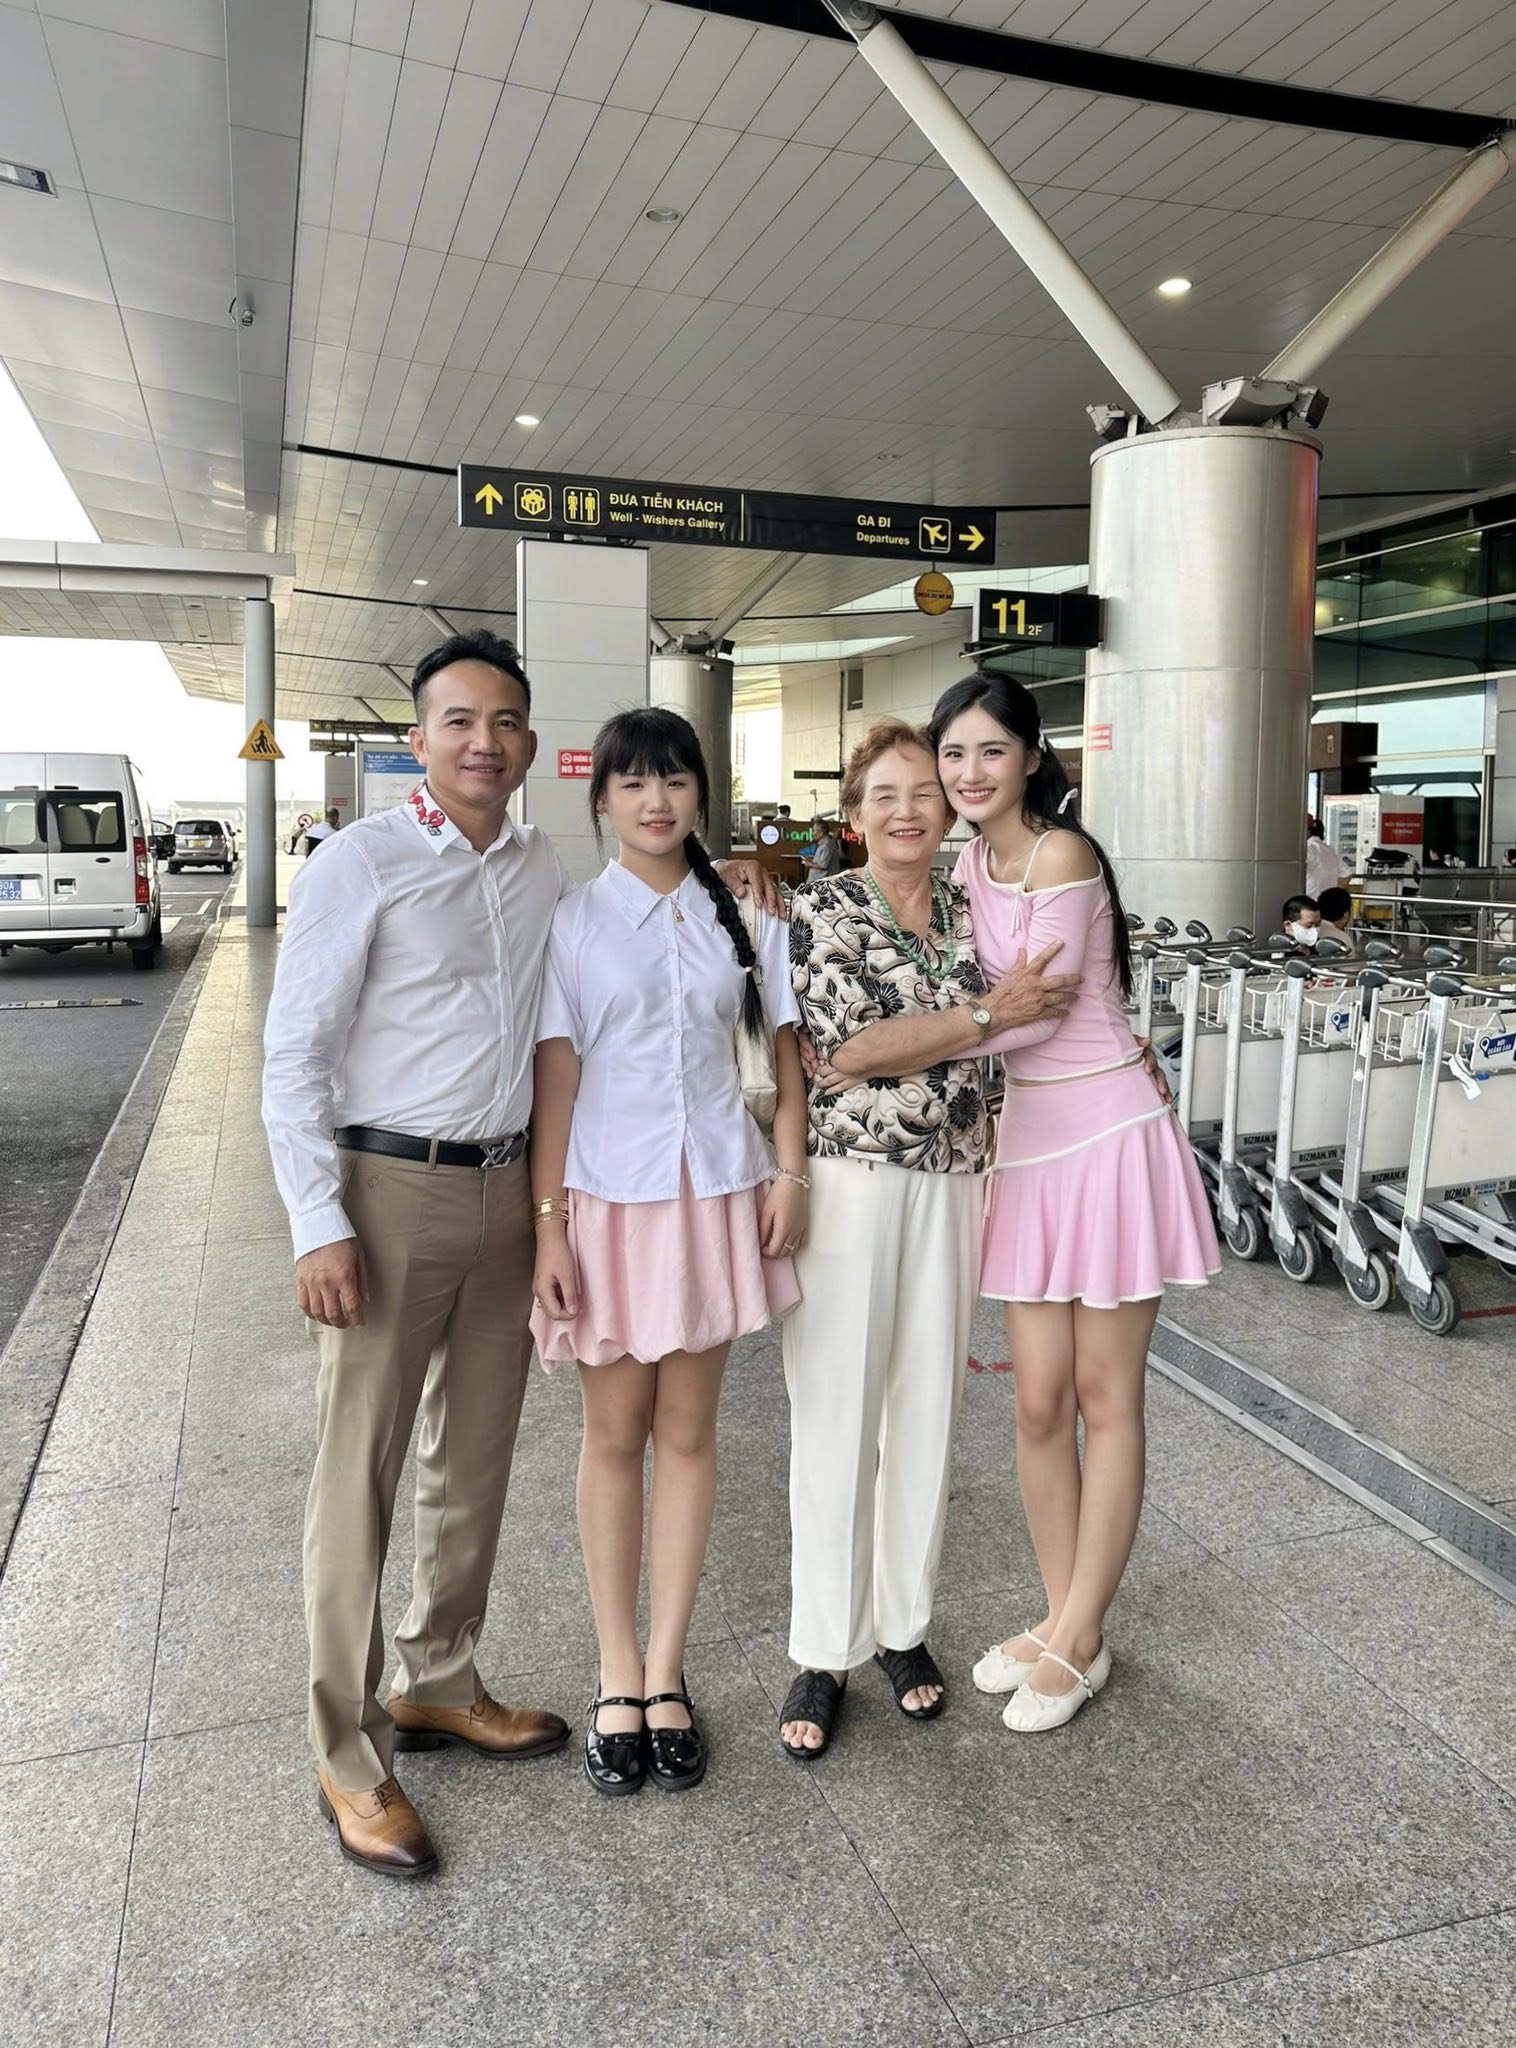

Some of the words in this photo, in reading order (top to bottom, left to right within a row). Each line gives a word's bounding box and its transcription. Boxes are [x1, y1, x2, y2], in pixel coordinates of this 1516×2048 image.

[609, 493, 638, 506] ĐƯA
[641, 492, 672, 509] TIỄN
[676, 498, 724, 513] KHÁCH
[609, 511, 633, 523] Well
[642, 513, 685, 527] Wishers
[687, 517, 725, 532] Gallery
[857, 514, 875, 527] GA
[878, 516, 891, 528] ĐI
[856, 532, 910, 545] Departures
[992, 597, 1025, 635] 11
[1028, 625, 1043, 636] 2F
[561, 765, 573, 774] NO
